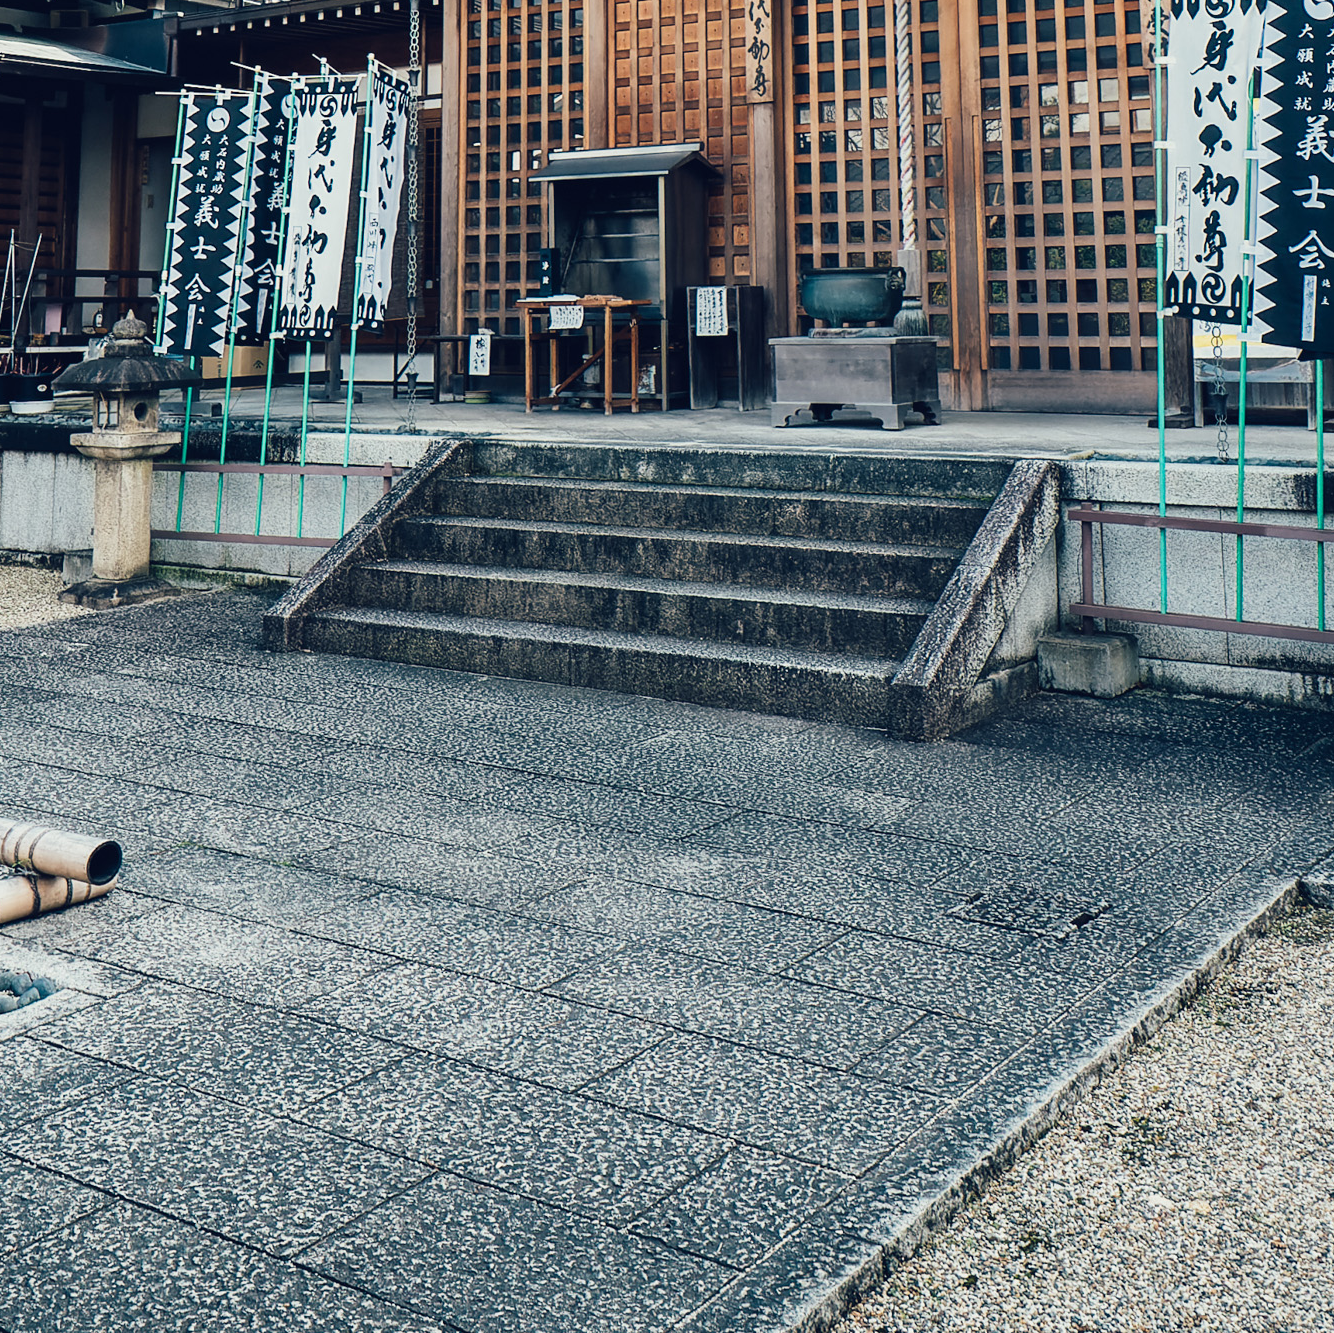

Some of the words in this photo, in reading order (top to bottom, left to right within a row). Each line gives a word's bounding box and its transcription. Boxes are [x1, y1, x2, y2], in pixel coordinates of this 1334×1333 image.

[1294, 23, 1315, 111] 大願成就
[195, 134, 212, 194] 大願成就
[210, 134, 229, 194] 大石内蔵助
[1190, 20, 1239, 272] 身代不動尊
[185, 195, 219, 301] 義士会
[254, 181, 289, 285] 義士会
